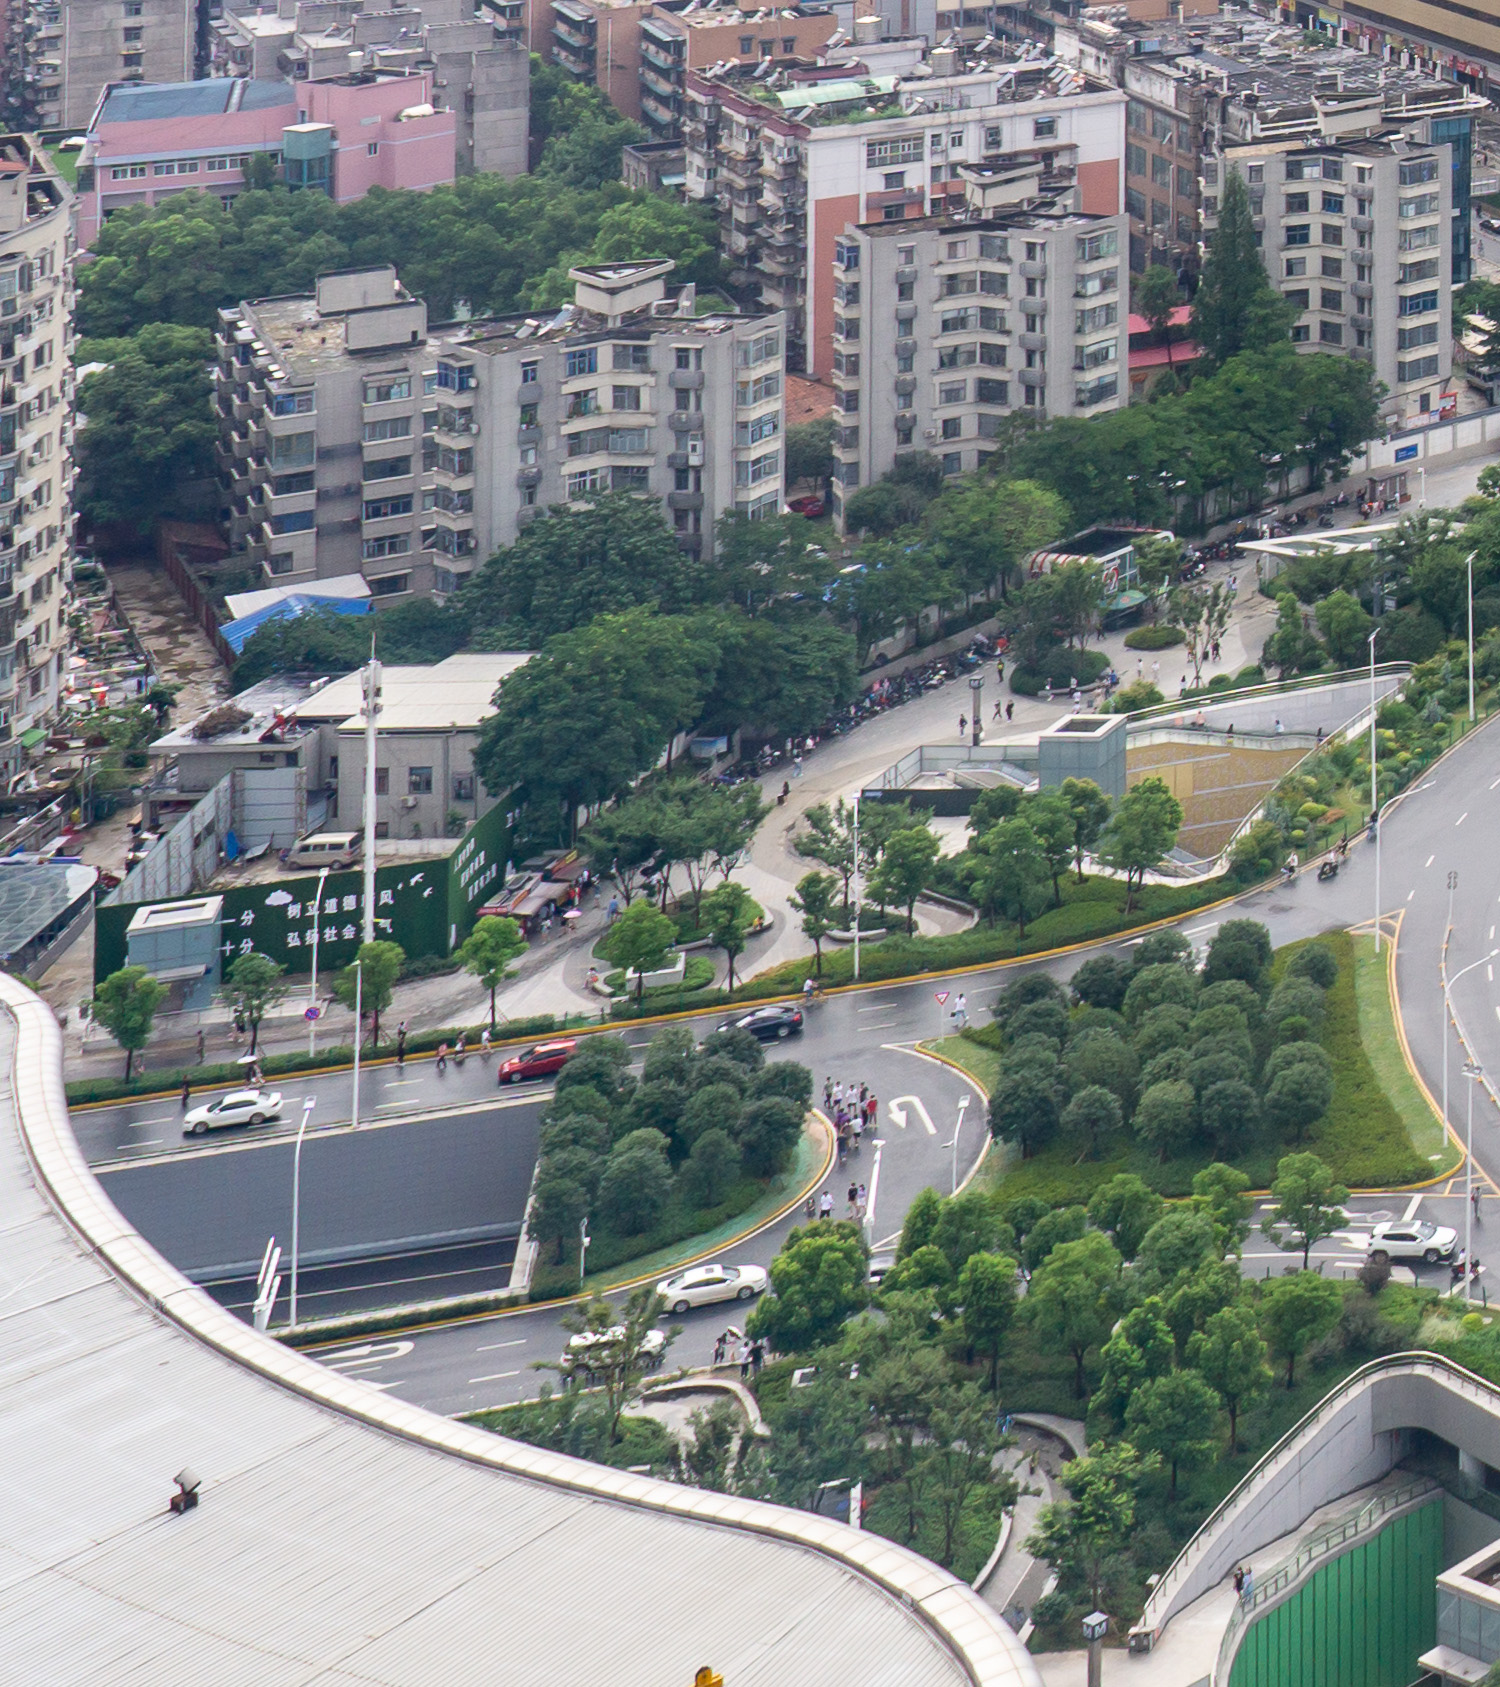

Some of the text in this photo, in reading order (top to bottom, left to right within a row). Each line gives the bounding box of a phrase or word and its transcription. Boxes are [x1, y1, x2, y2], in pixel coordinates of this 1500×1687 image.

[287, 889, 394, 919] 树立道德风
[287, 918, 393, 949] 弘扬社会气
